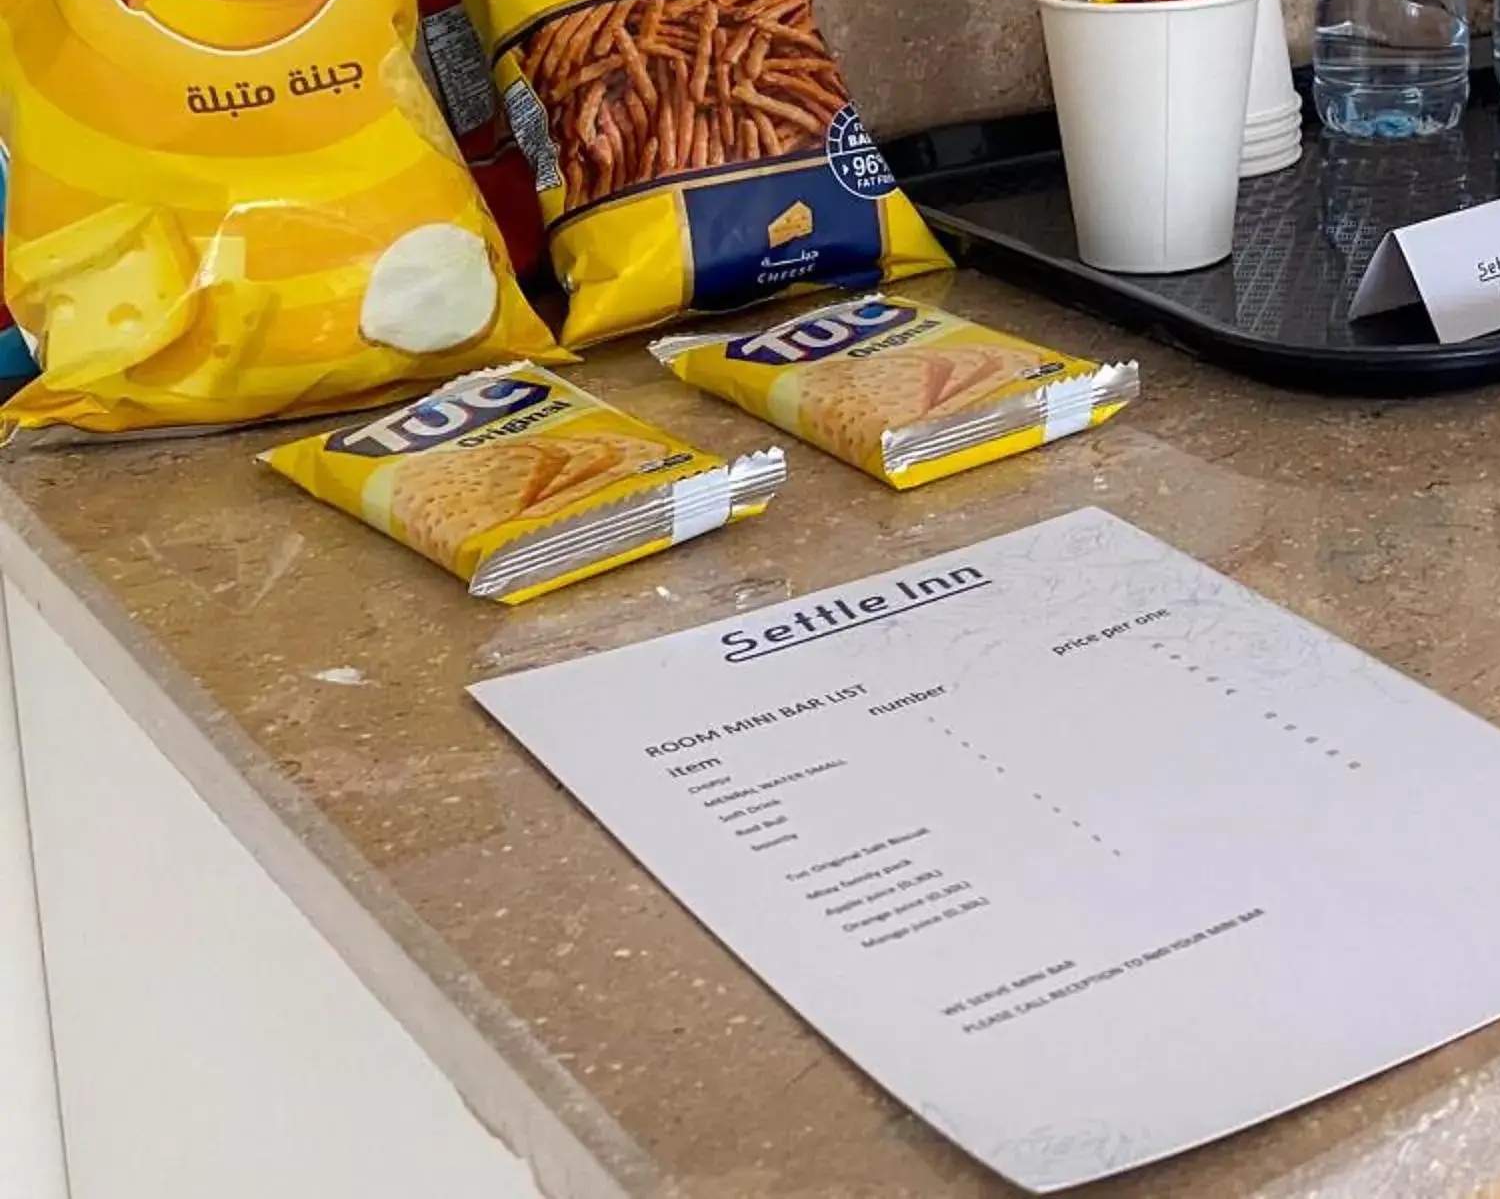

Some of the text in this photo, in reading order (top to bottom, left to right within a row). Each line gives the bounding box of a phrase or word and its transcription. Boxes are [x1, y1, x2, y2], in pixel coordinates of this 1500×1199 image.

[187, 60, 364, 118] جبنة متبلة
[757, 262, 815, 284] CHEESE
[742, 300, 901, 362] TUC
[847, 319, 942, 358] Original
[342, 377, 531, 453] TUC
[457, 400, 572, 447] Original
[720, 565, 984, 658] Settle Inn
[645, 683, 869, 758] ROOM MINI BAR LIST
[667, 607, 1172, 779] item number price per one
